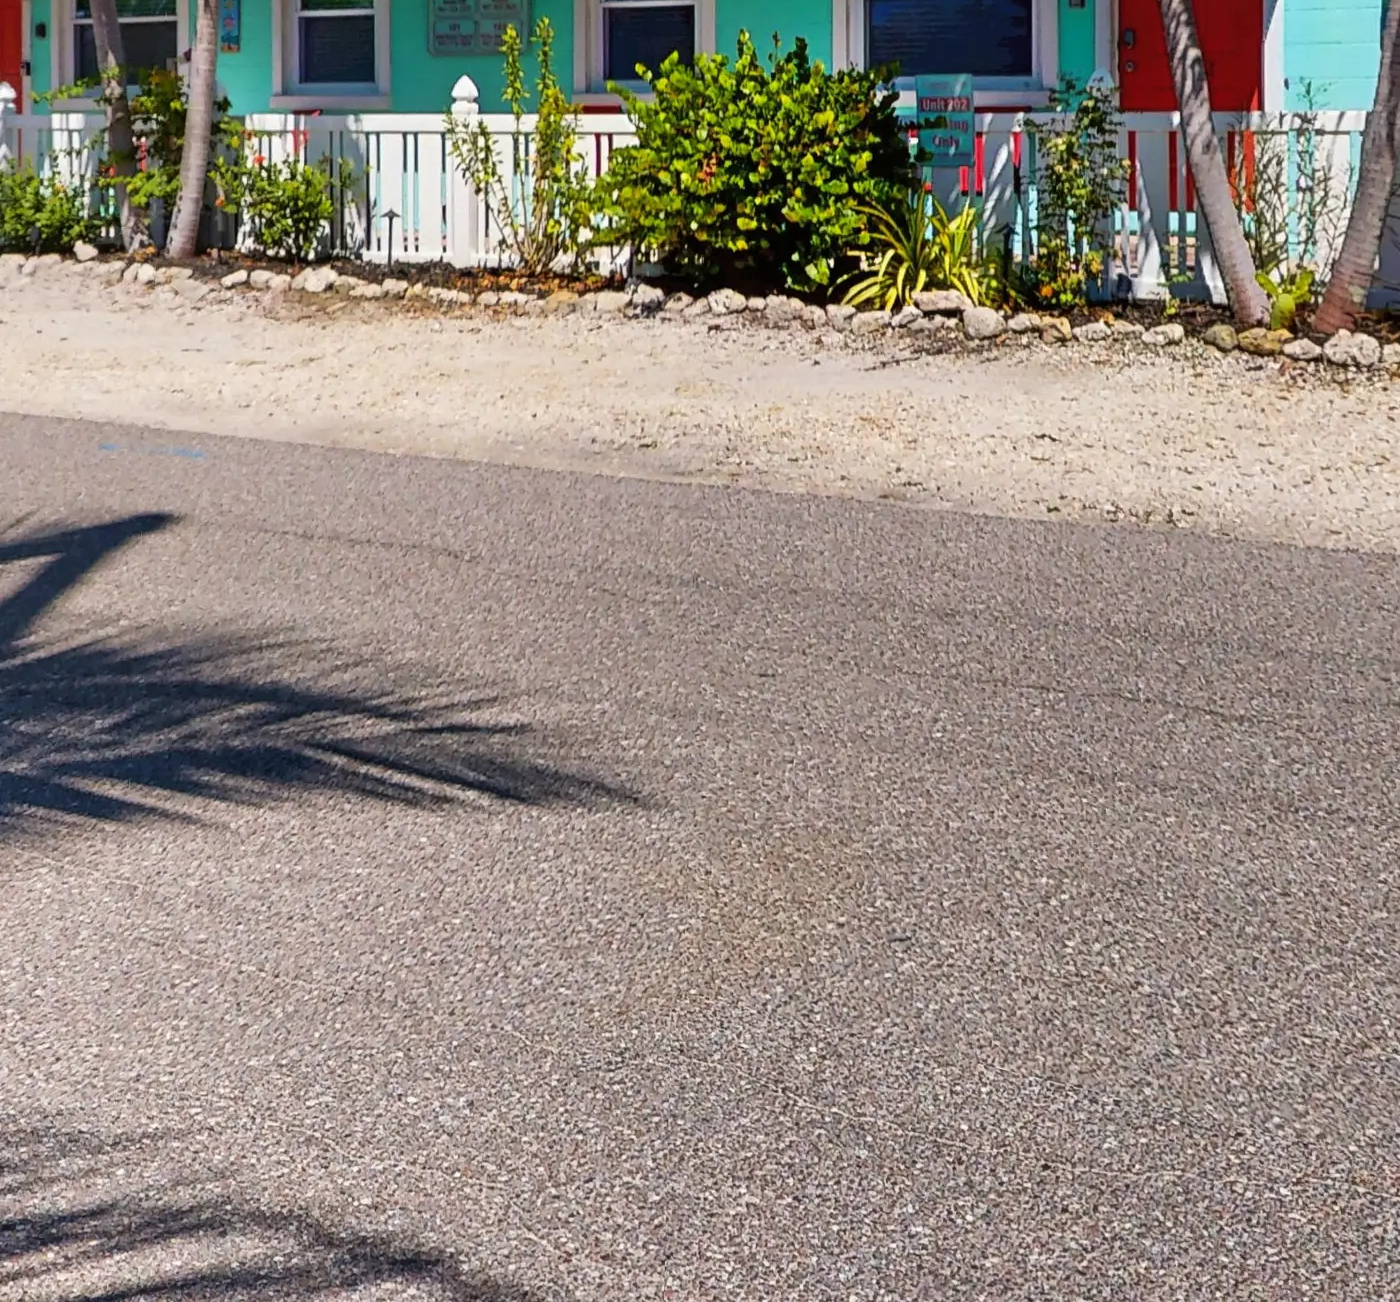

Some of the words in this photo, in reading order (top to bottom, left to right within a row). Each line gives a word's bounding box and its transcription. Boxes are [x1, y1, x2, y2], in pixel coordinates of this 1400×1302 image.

[922, 98, 945, 111] Unit
[947, 98, 968, 111] 202
[932, 135, 960, 150] Only
